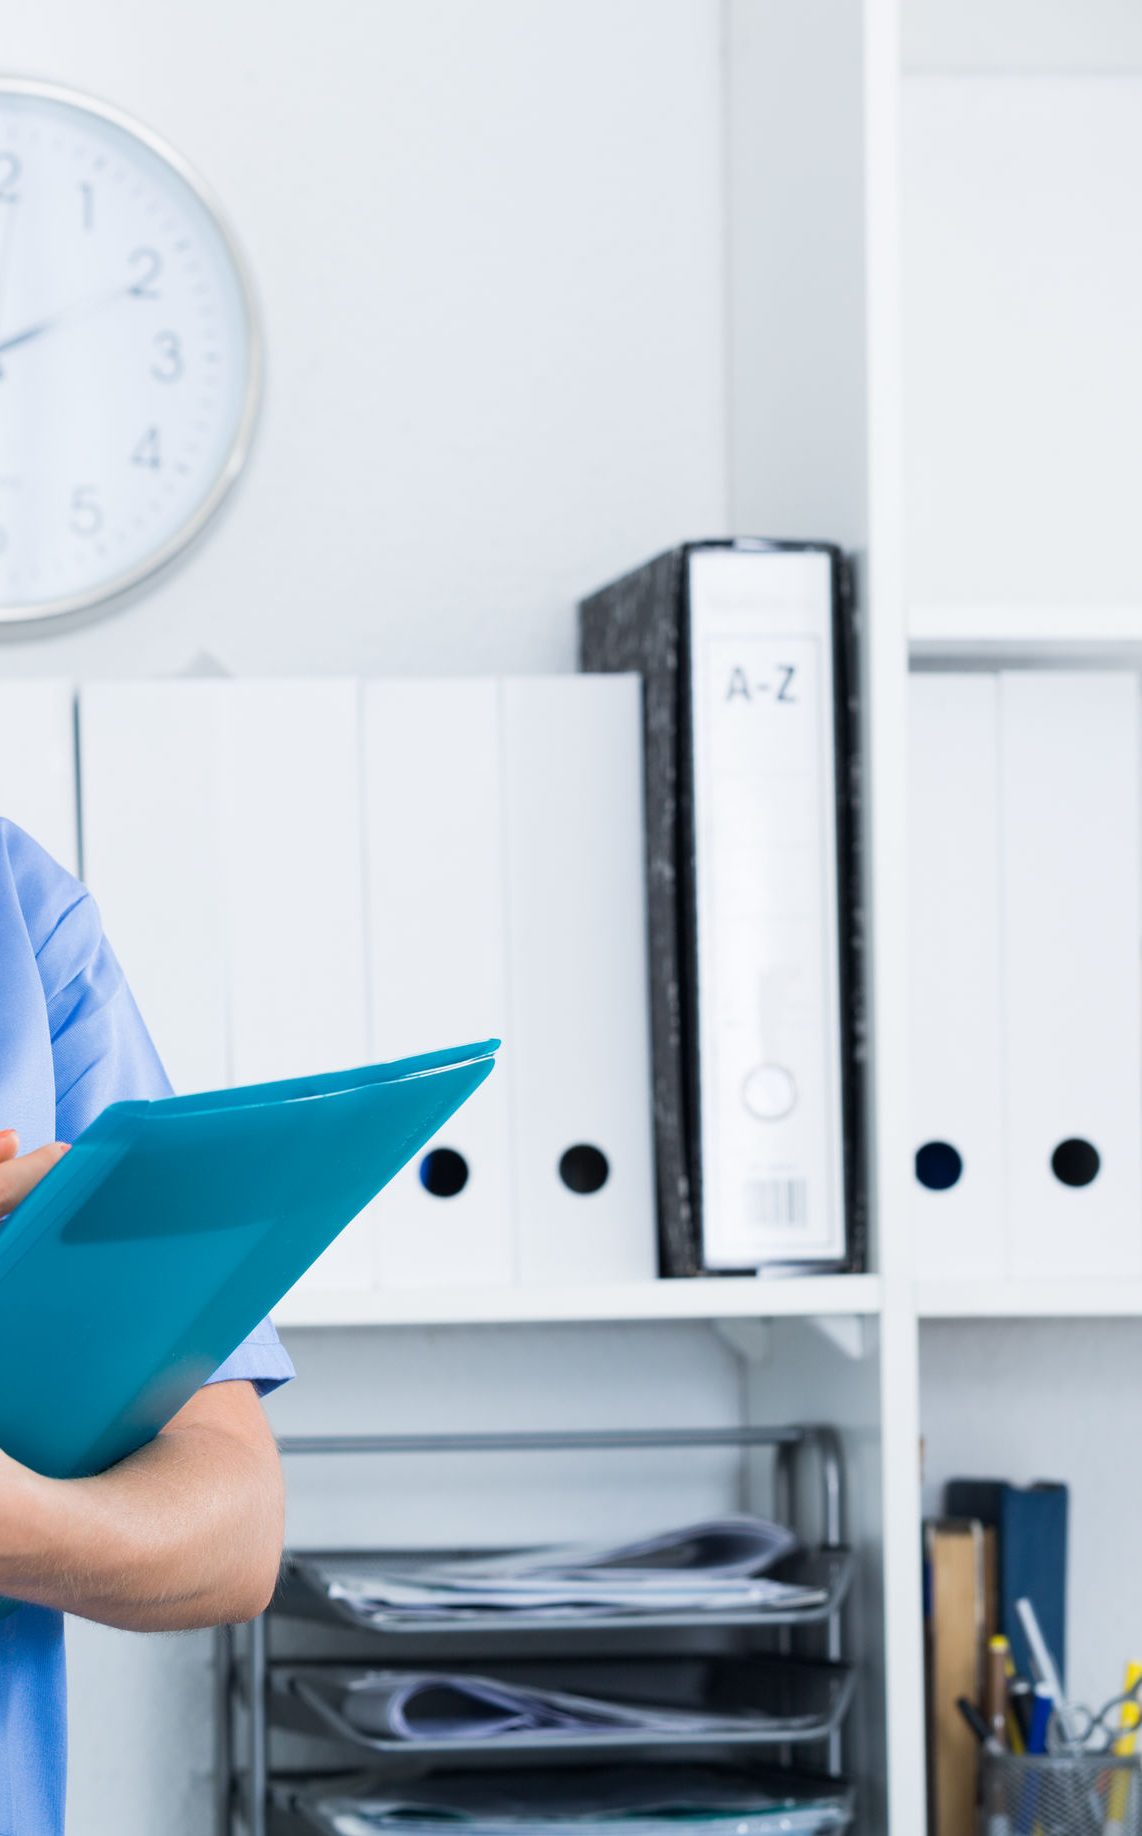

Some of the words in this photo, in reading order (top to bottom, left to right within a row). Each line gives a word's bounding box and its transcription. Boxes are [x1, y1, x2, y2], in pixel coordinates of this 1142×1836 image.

[77, 179, 97, 232] 1
[125, 247, 163, 301] 2
[151, 330, 185, 385] 3
[129, 425, 163, 471] 4
[68, 484, 104, 539] 5
[725, 664, 798, 703] A-Z
